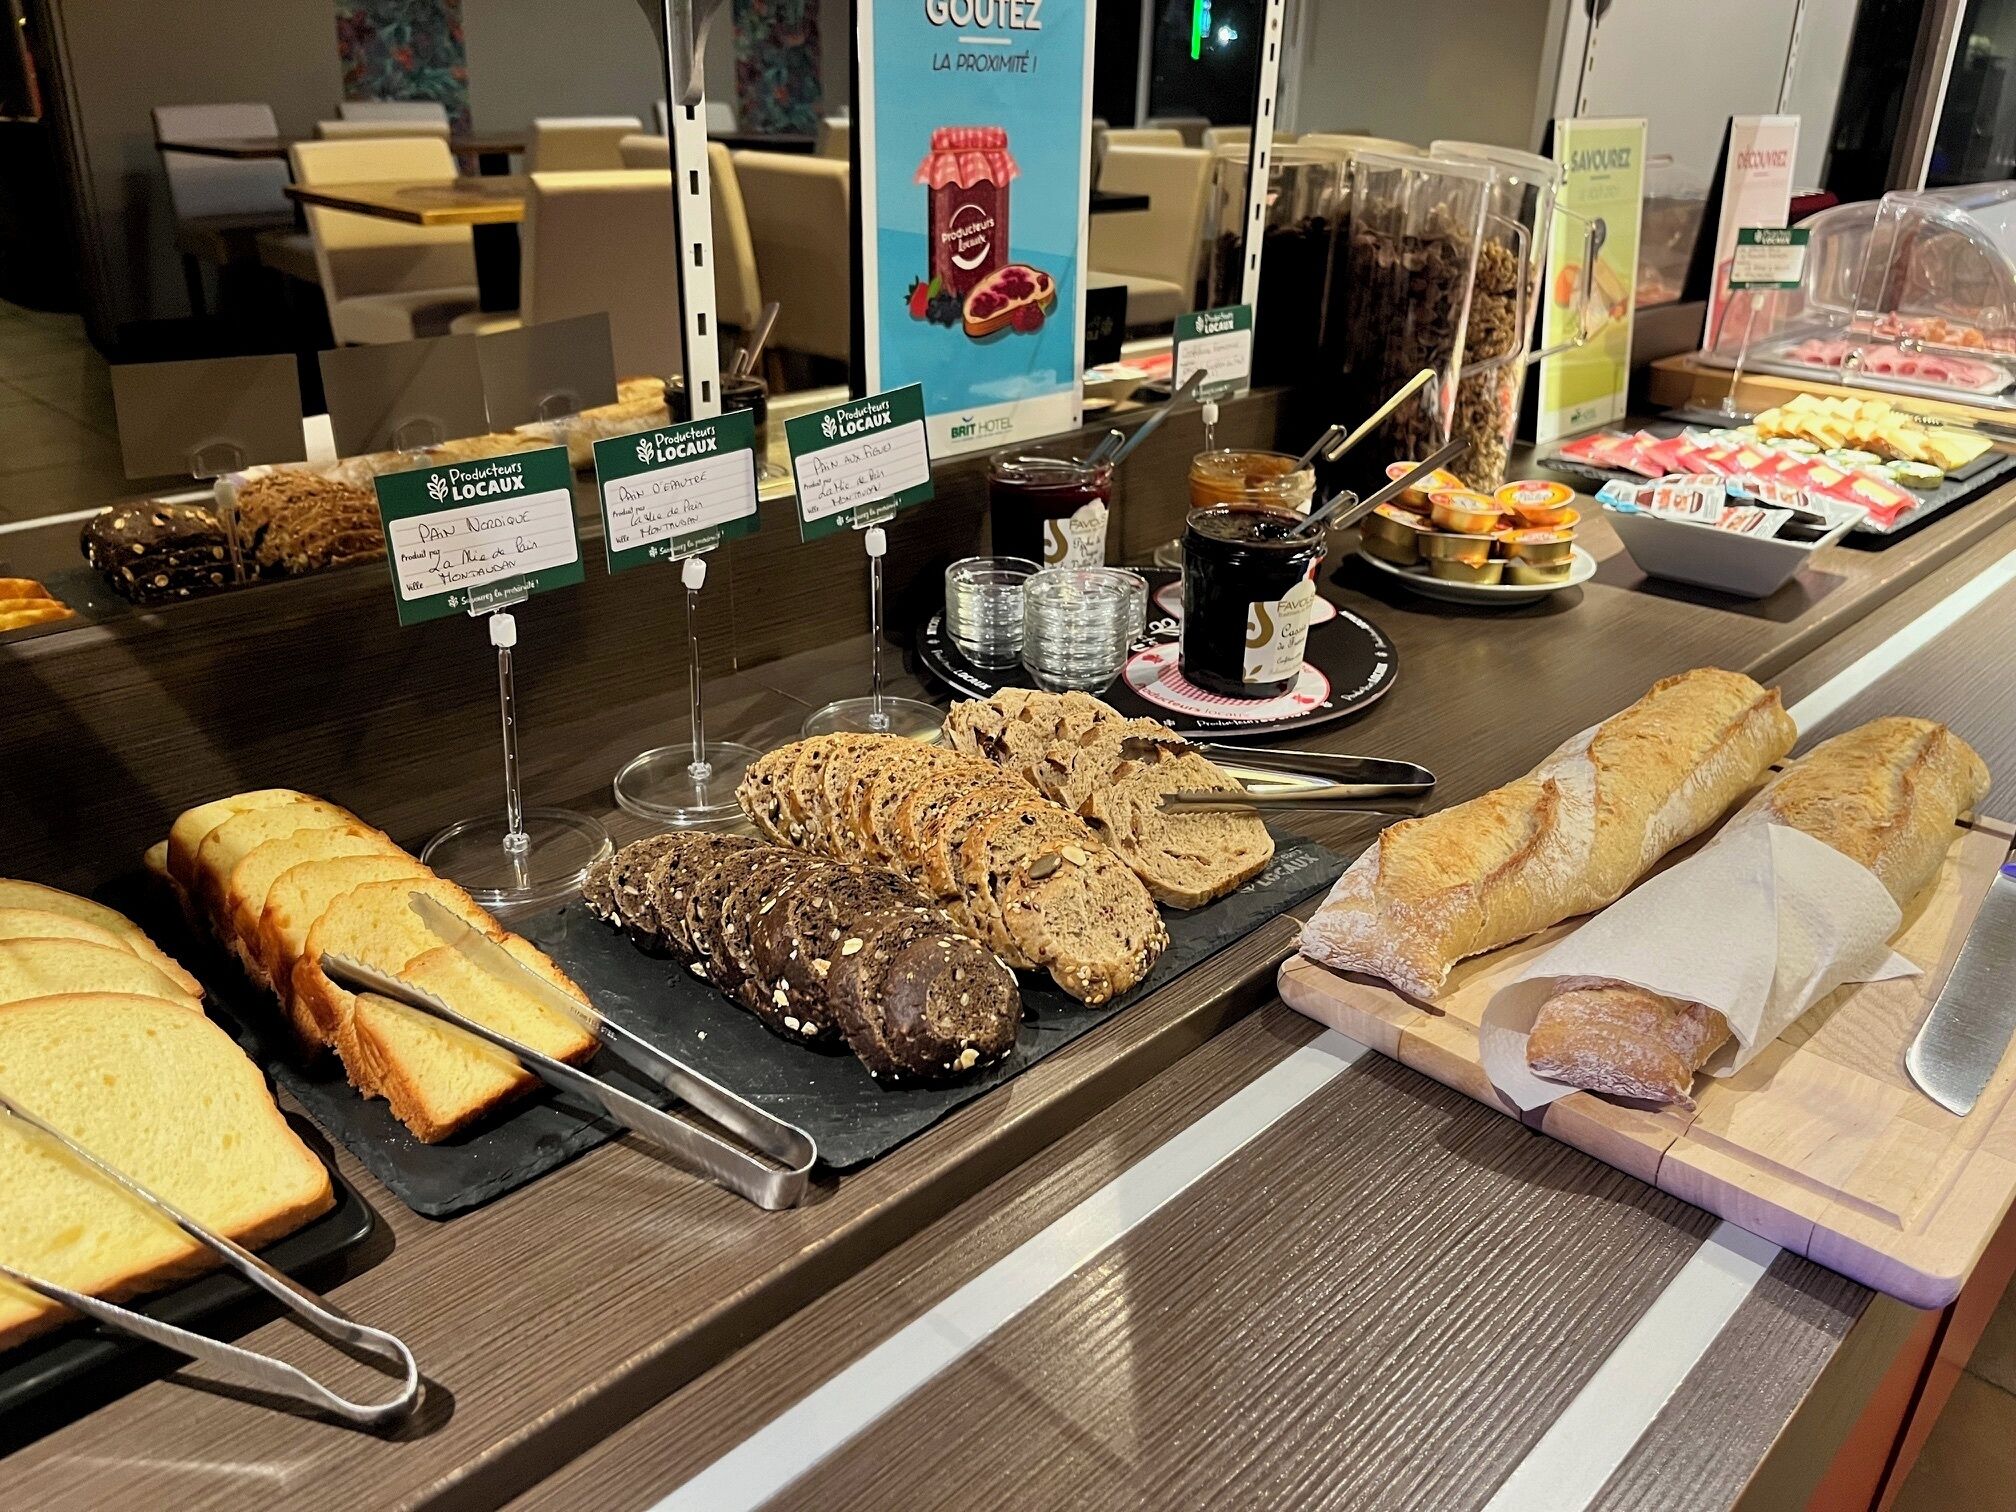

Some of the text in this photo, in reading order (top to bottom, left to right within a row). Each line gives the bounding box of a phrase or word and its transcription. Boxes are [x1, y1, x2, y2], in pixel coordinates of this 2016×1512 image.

[932, 53, 951, 71] LA
[956, 49, 1030, 73] PROXIMITÉ
[1570, 148, 1632, 172] SAVOUREZ
[941, 218, 995, 244] Producteurs
[1204, 320, 1234, 334] LOCAUX
[837, 400, 890, 424] Producteurs
[839, 411, 892, 438] LOCAUX
[951, 423, 976, 439] BRIT
[978, 416, 1013, 434] HOTEL
[655, 426, 716, 448] Producteurs
[657, 437, 718, 463] LOCAUX
[449, 462, 522, 485] Producteurs
[452, 475, 525, 501] LOCAUX
[401, 549, 427, 562] Produit
[406, 581, 424, 592] Ville
